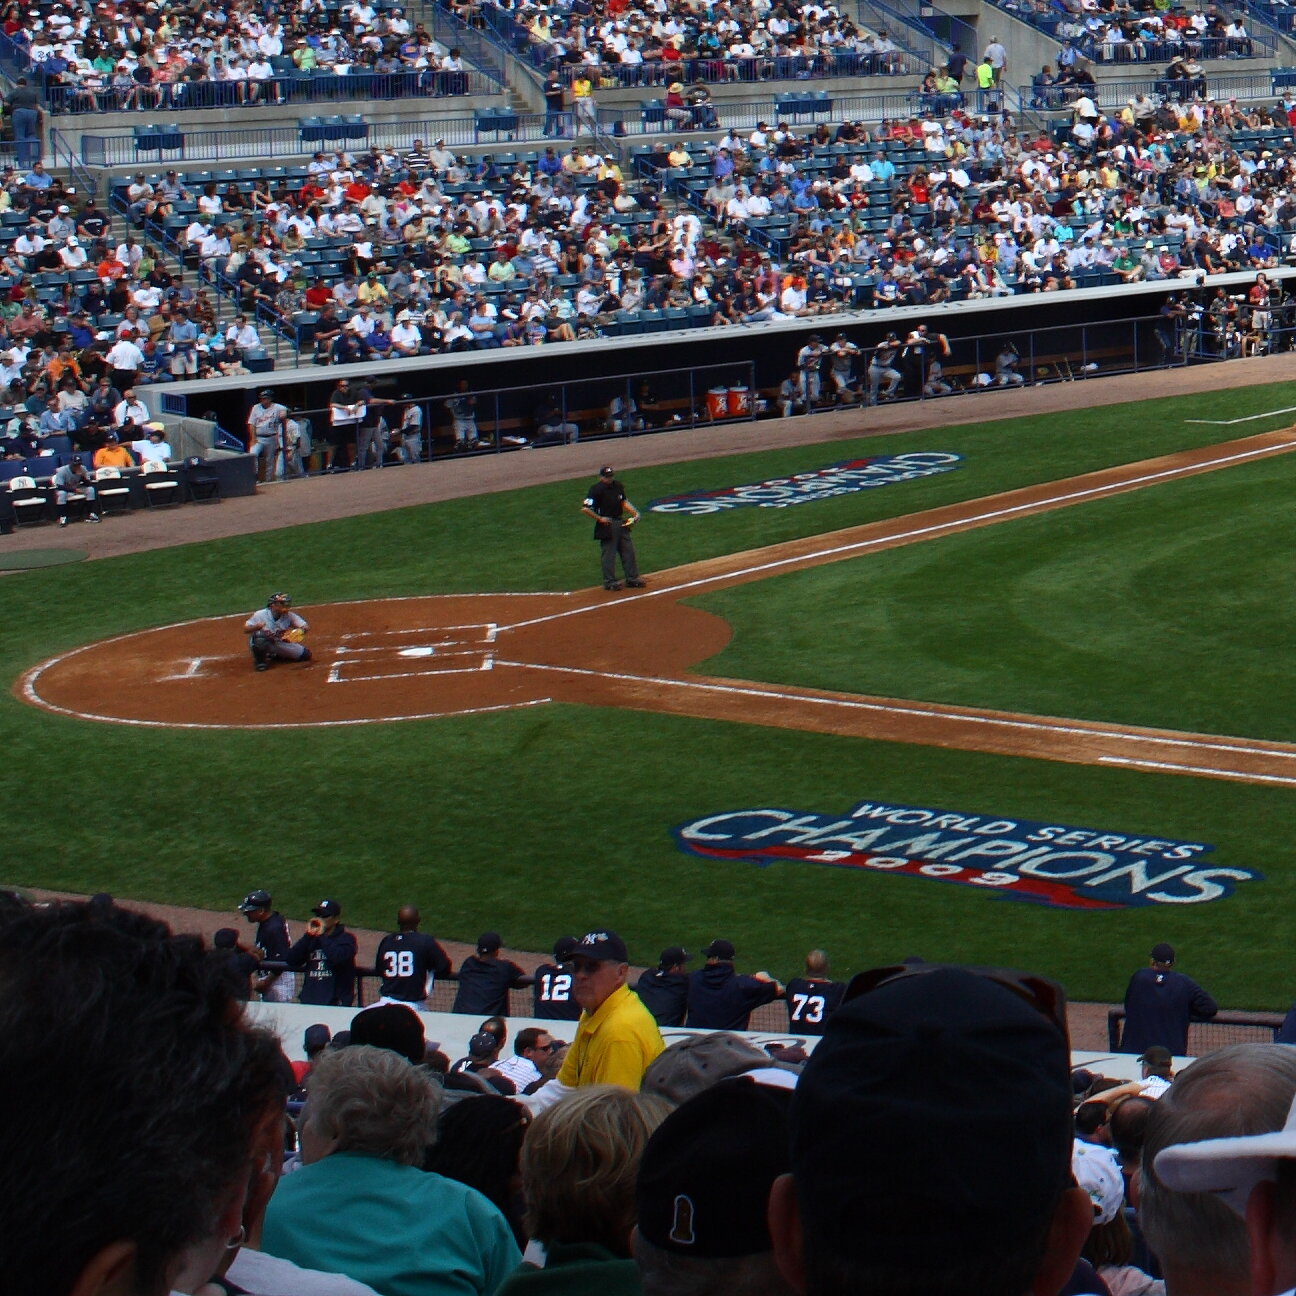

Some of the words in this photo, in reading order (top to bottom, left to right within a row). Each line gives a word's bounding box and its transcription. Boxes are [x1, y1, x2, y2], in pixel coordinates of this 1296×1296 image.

[851, 803, 1018, 834] WORLD
[1026, 826, 1205, 859] SERIES
[680, 808, 1253, 904] CHAMPIONS
[804, 849, 1020, 887] 2009
[383, 950, 415, 978] 38
[540, 973, 572, 1002] 12
[792, 993, 826, 1024] 73
